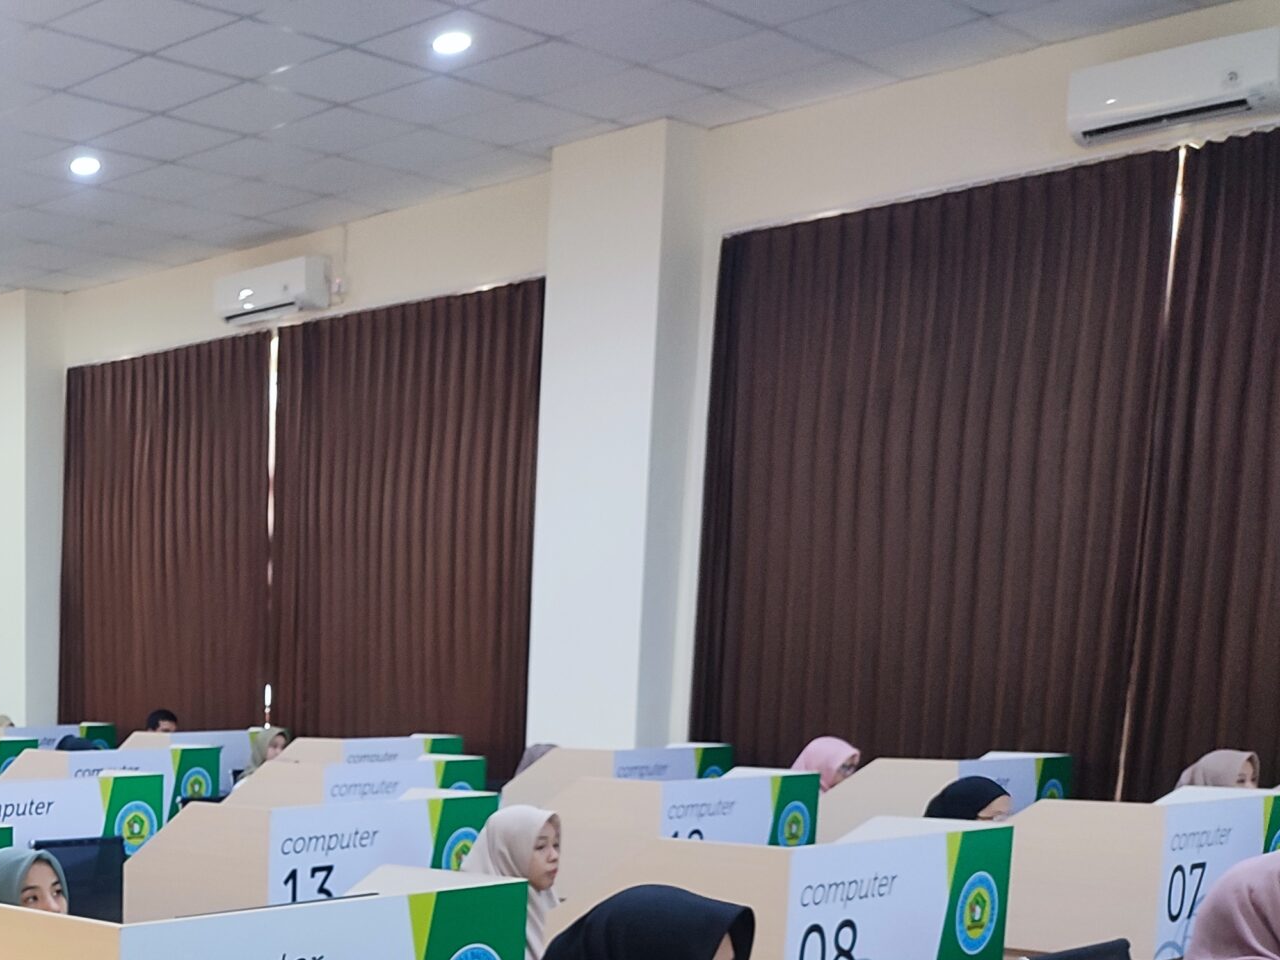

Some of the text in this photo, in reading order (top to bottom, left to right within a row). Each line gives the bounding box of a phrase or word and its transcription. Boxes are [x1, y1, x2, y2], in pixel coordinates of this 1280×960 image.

[331, 781, 400, 799] computer
[667, 800, 735, 819] computer
[281, 828, 378, 857] computer
[1171, 826, 1233, 854] computer
[283, 865, 334, 902] 13
[800, 873, 898, 910] computer
[1167, 862, 1207, 923] 07
